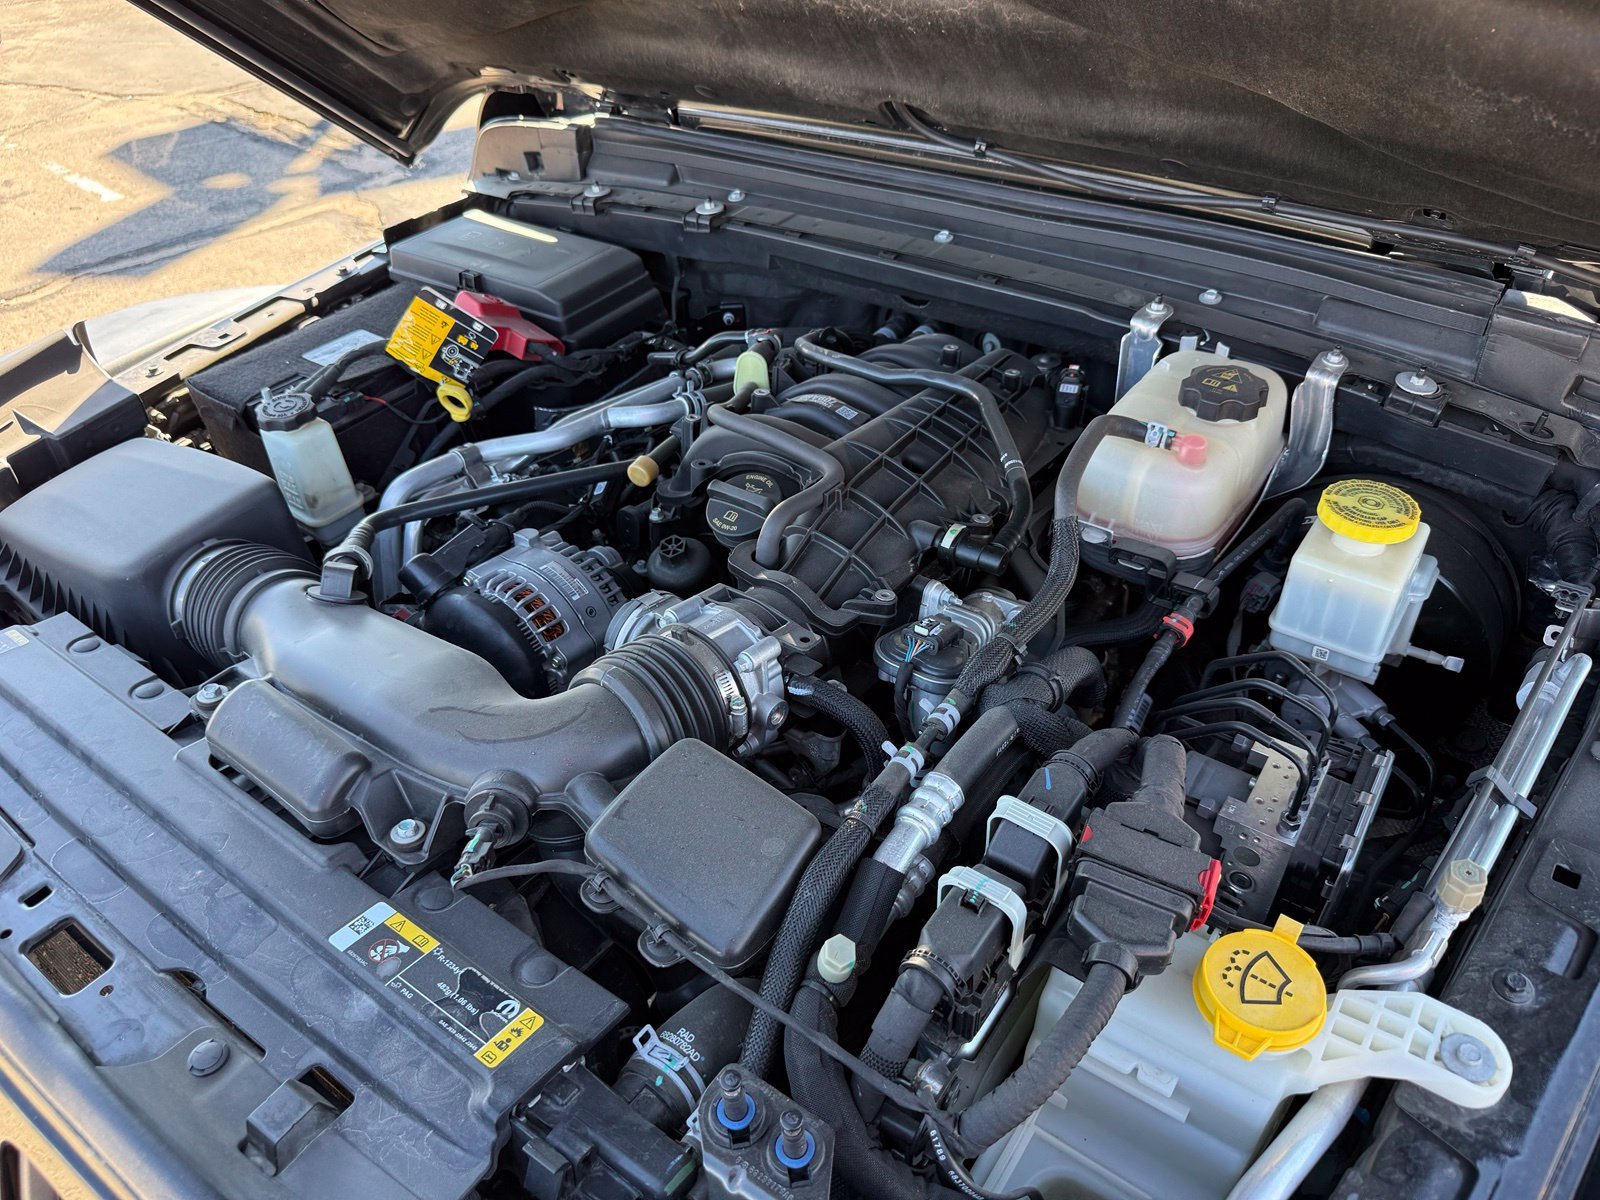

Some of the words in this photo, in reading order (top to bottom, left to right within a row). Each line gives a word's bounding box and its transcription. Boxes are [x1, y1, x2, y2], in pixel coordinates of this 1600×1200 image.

[745, 474, 766, 482] ENGINE
[765, 480, 774, 488] OIL
[712, 517, 720, 528] SAE
[400, 987, 414, 999] PAG
[436, 981, 452, 997] 482g
[450, 993, 468, 1006] (1.06
[465, 1002, 480, 1015] lbs)
[676, 1027, 695, 1042] RAD
[930, 1129, 946, 1161] 61789
